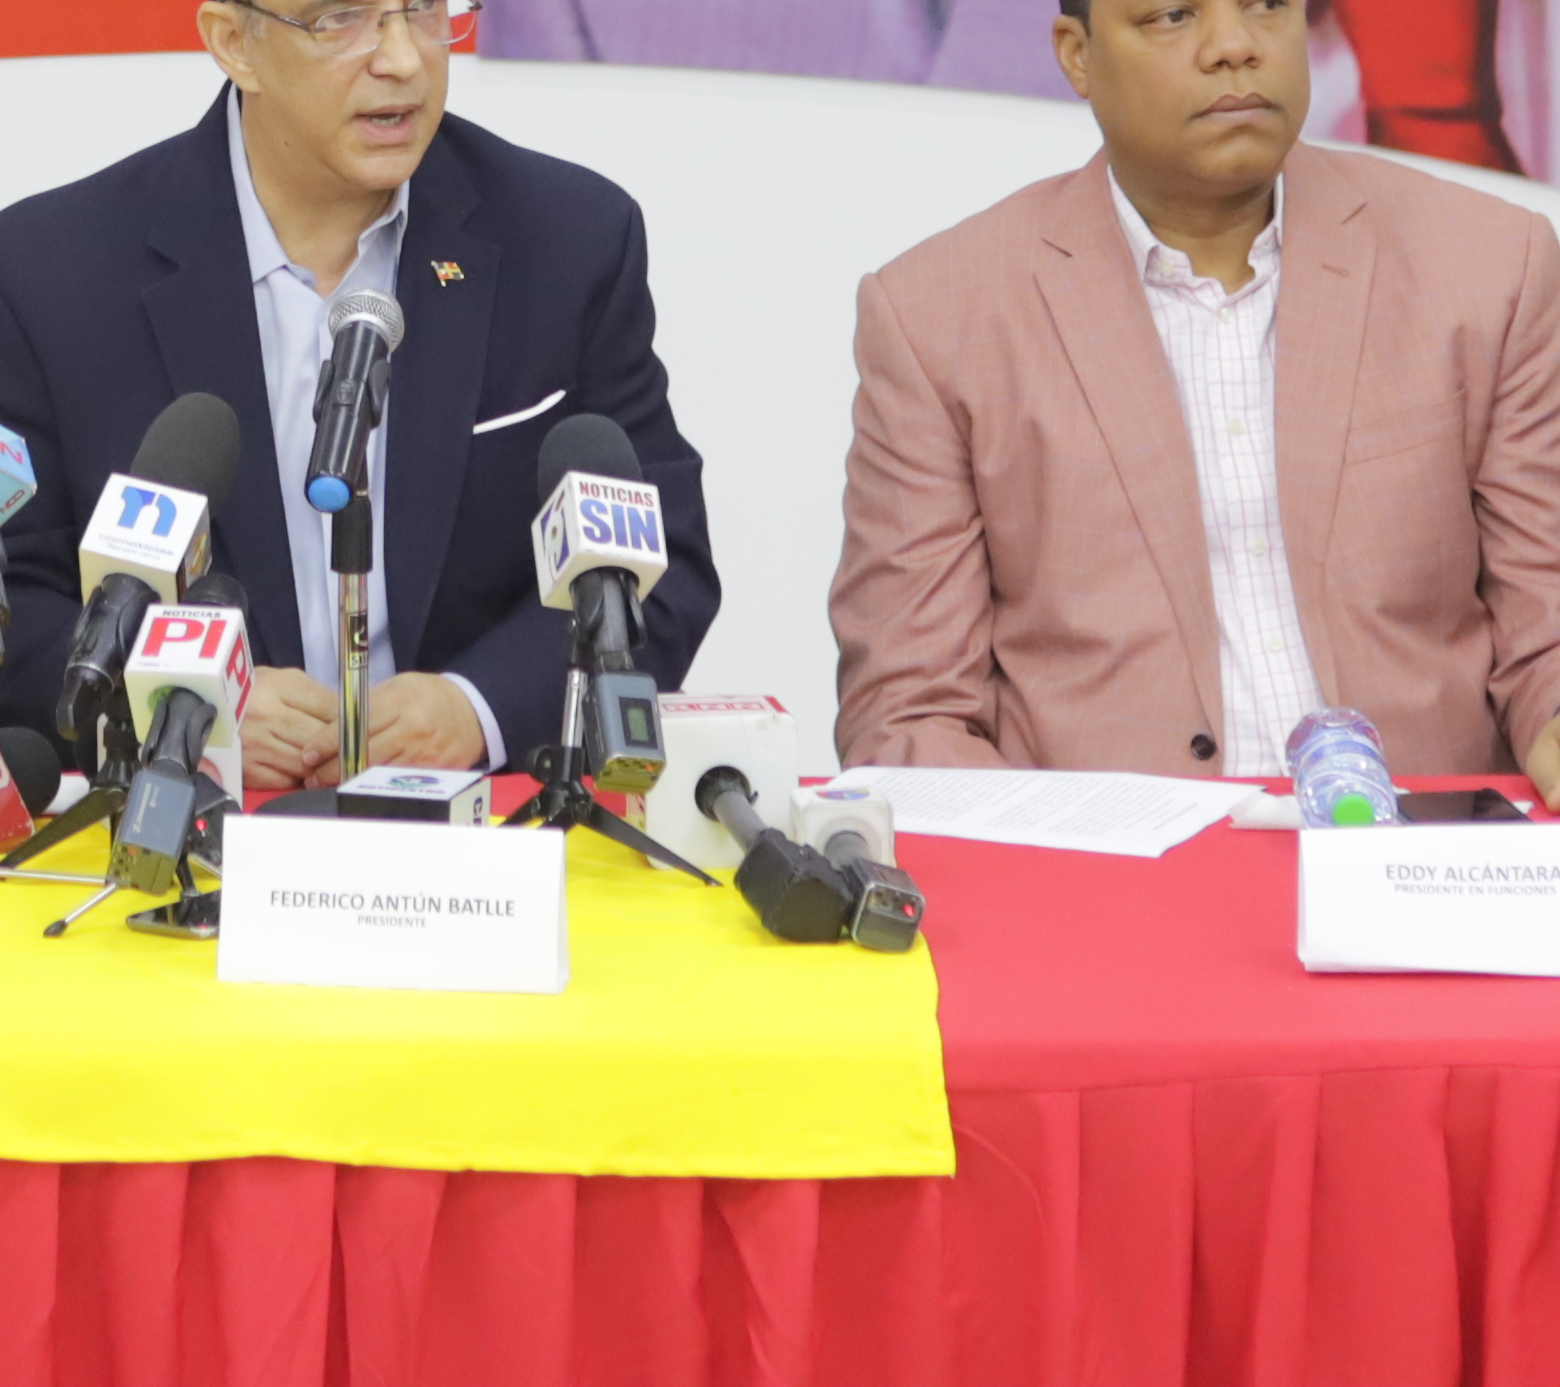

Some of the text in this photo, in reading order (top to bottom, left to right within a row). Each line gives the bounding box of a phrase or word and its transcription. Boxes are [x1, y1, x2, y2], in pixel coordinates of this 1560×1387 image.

[579, 481, 654, 508] NOTICIAS
[580, 499, 660, 554] SIN
[162, 610, 221, 618] NOTICIAS
[141, 617, 227, 659] PI
[1385, 864, 1437, 881] EDDY
[1394, 884, 1557, 895] PRESIDENTE EN FUNCIONES
[270, 890, 516, 917] FEDERICO ANTÚN BATLLE
[357, 915, 427, 928] PRESIDENTE
